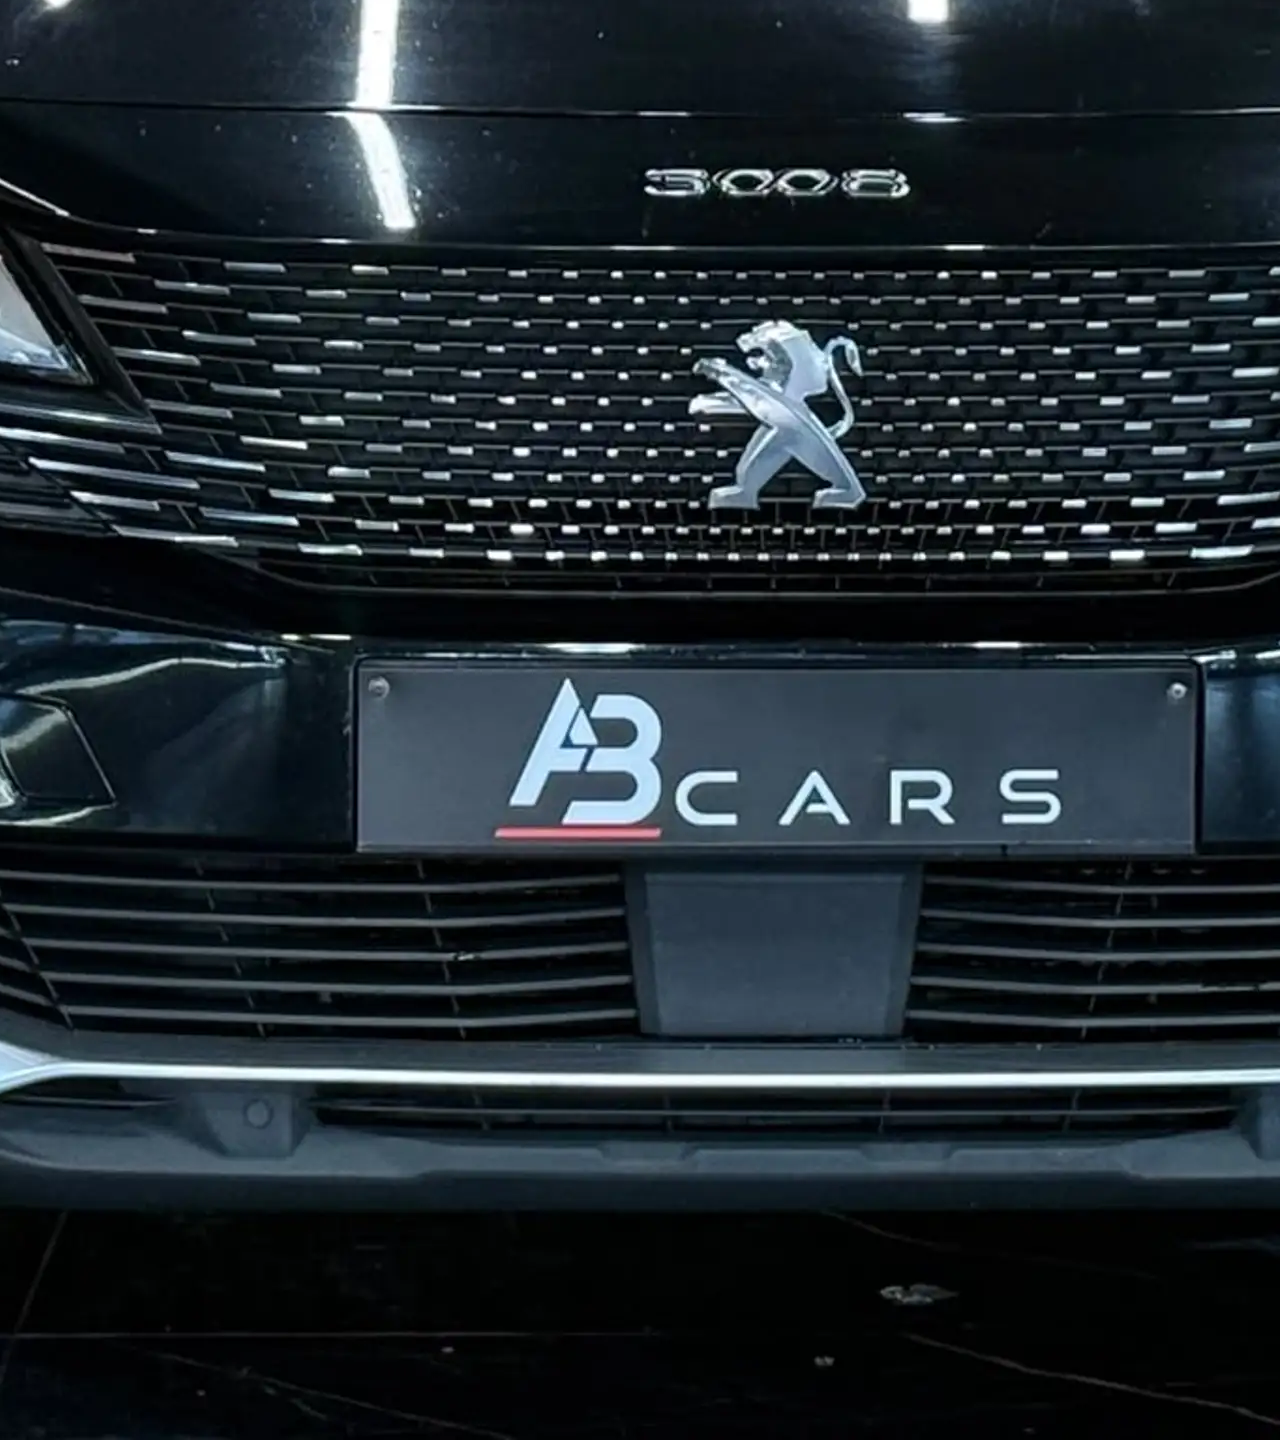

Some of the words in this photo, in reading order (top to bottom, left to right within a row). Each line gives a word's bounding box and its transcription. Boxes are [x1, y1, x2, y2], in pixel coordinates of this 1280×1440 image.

[644, 168, 912, 198] 3008
[509, 678, 662, 826] AB
[674, 769, 1063, 826] CARS
